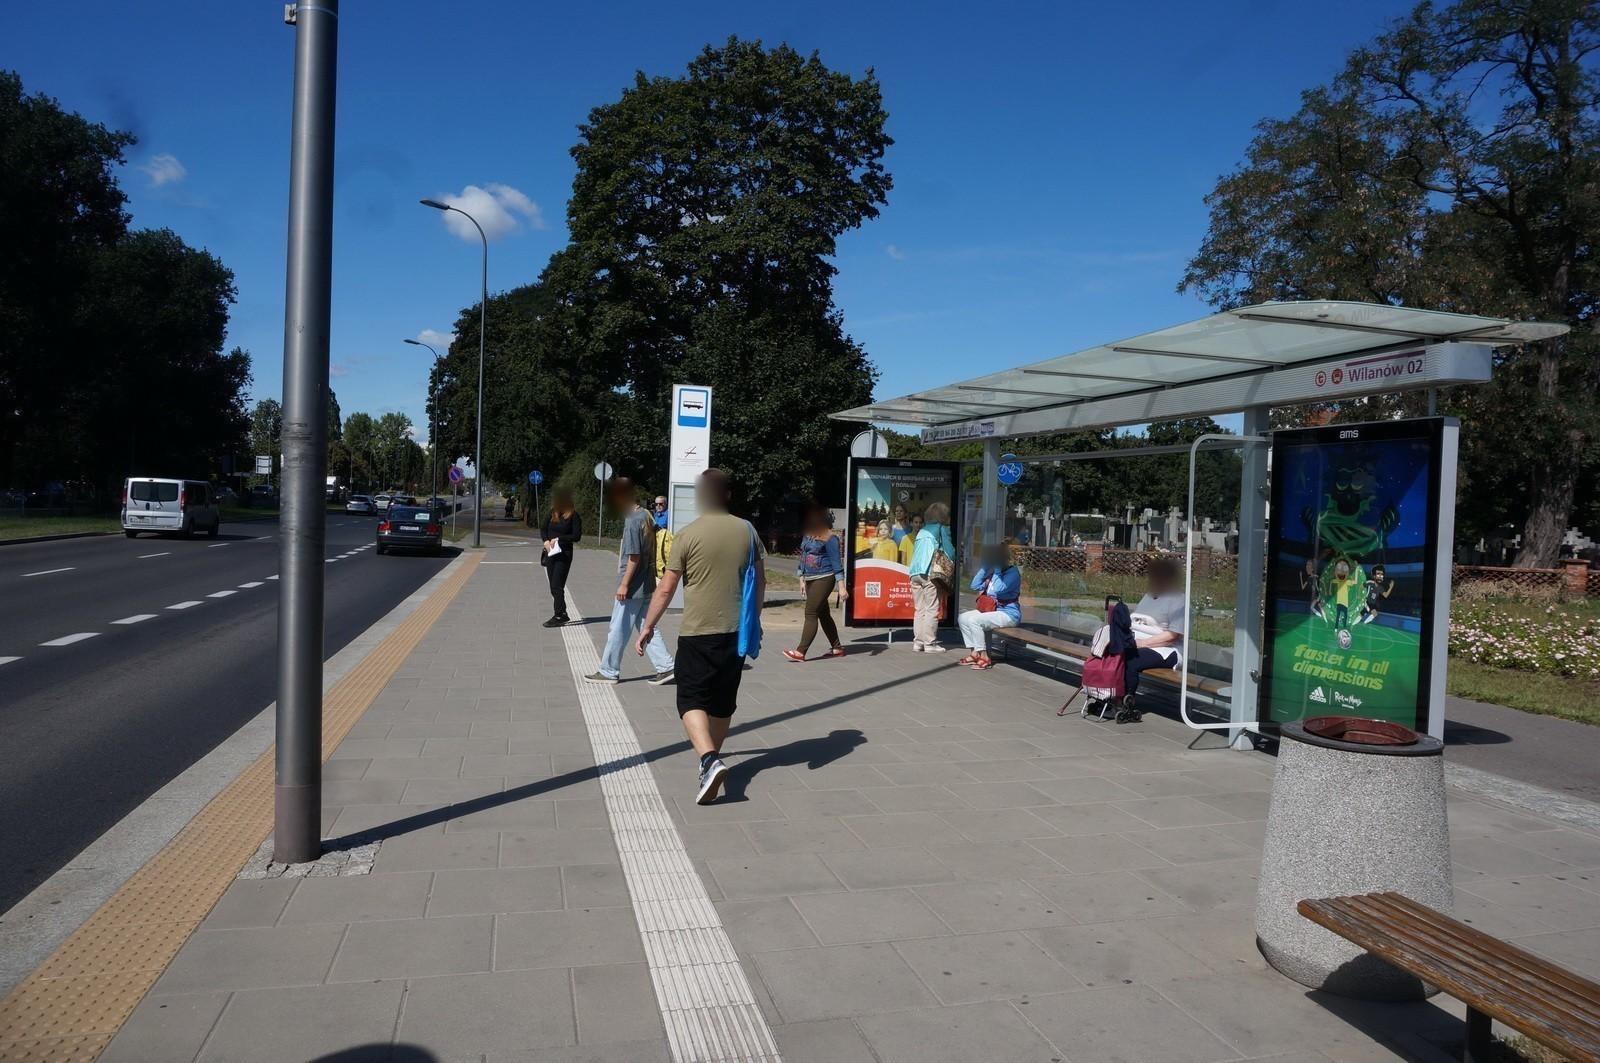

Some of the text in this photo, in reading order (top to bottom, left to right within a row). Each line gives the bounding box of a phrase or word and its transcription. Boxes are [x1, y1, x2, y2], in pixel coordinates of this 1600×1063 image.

[1349, 360, 1423, 382] Wilanów 02
[1340, 430, 1359, 439] ams
[1294, 644, 1389, 675] faster in all
[1293, 662, 1383, 690] dimensions
